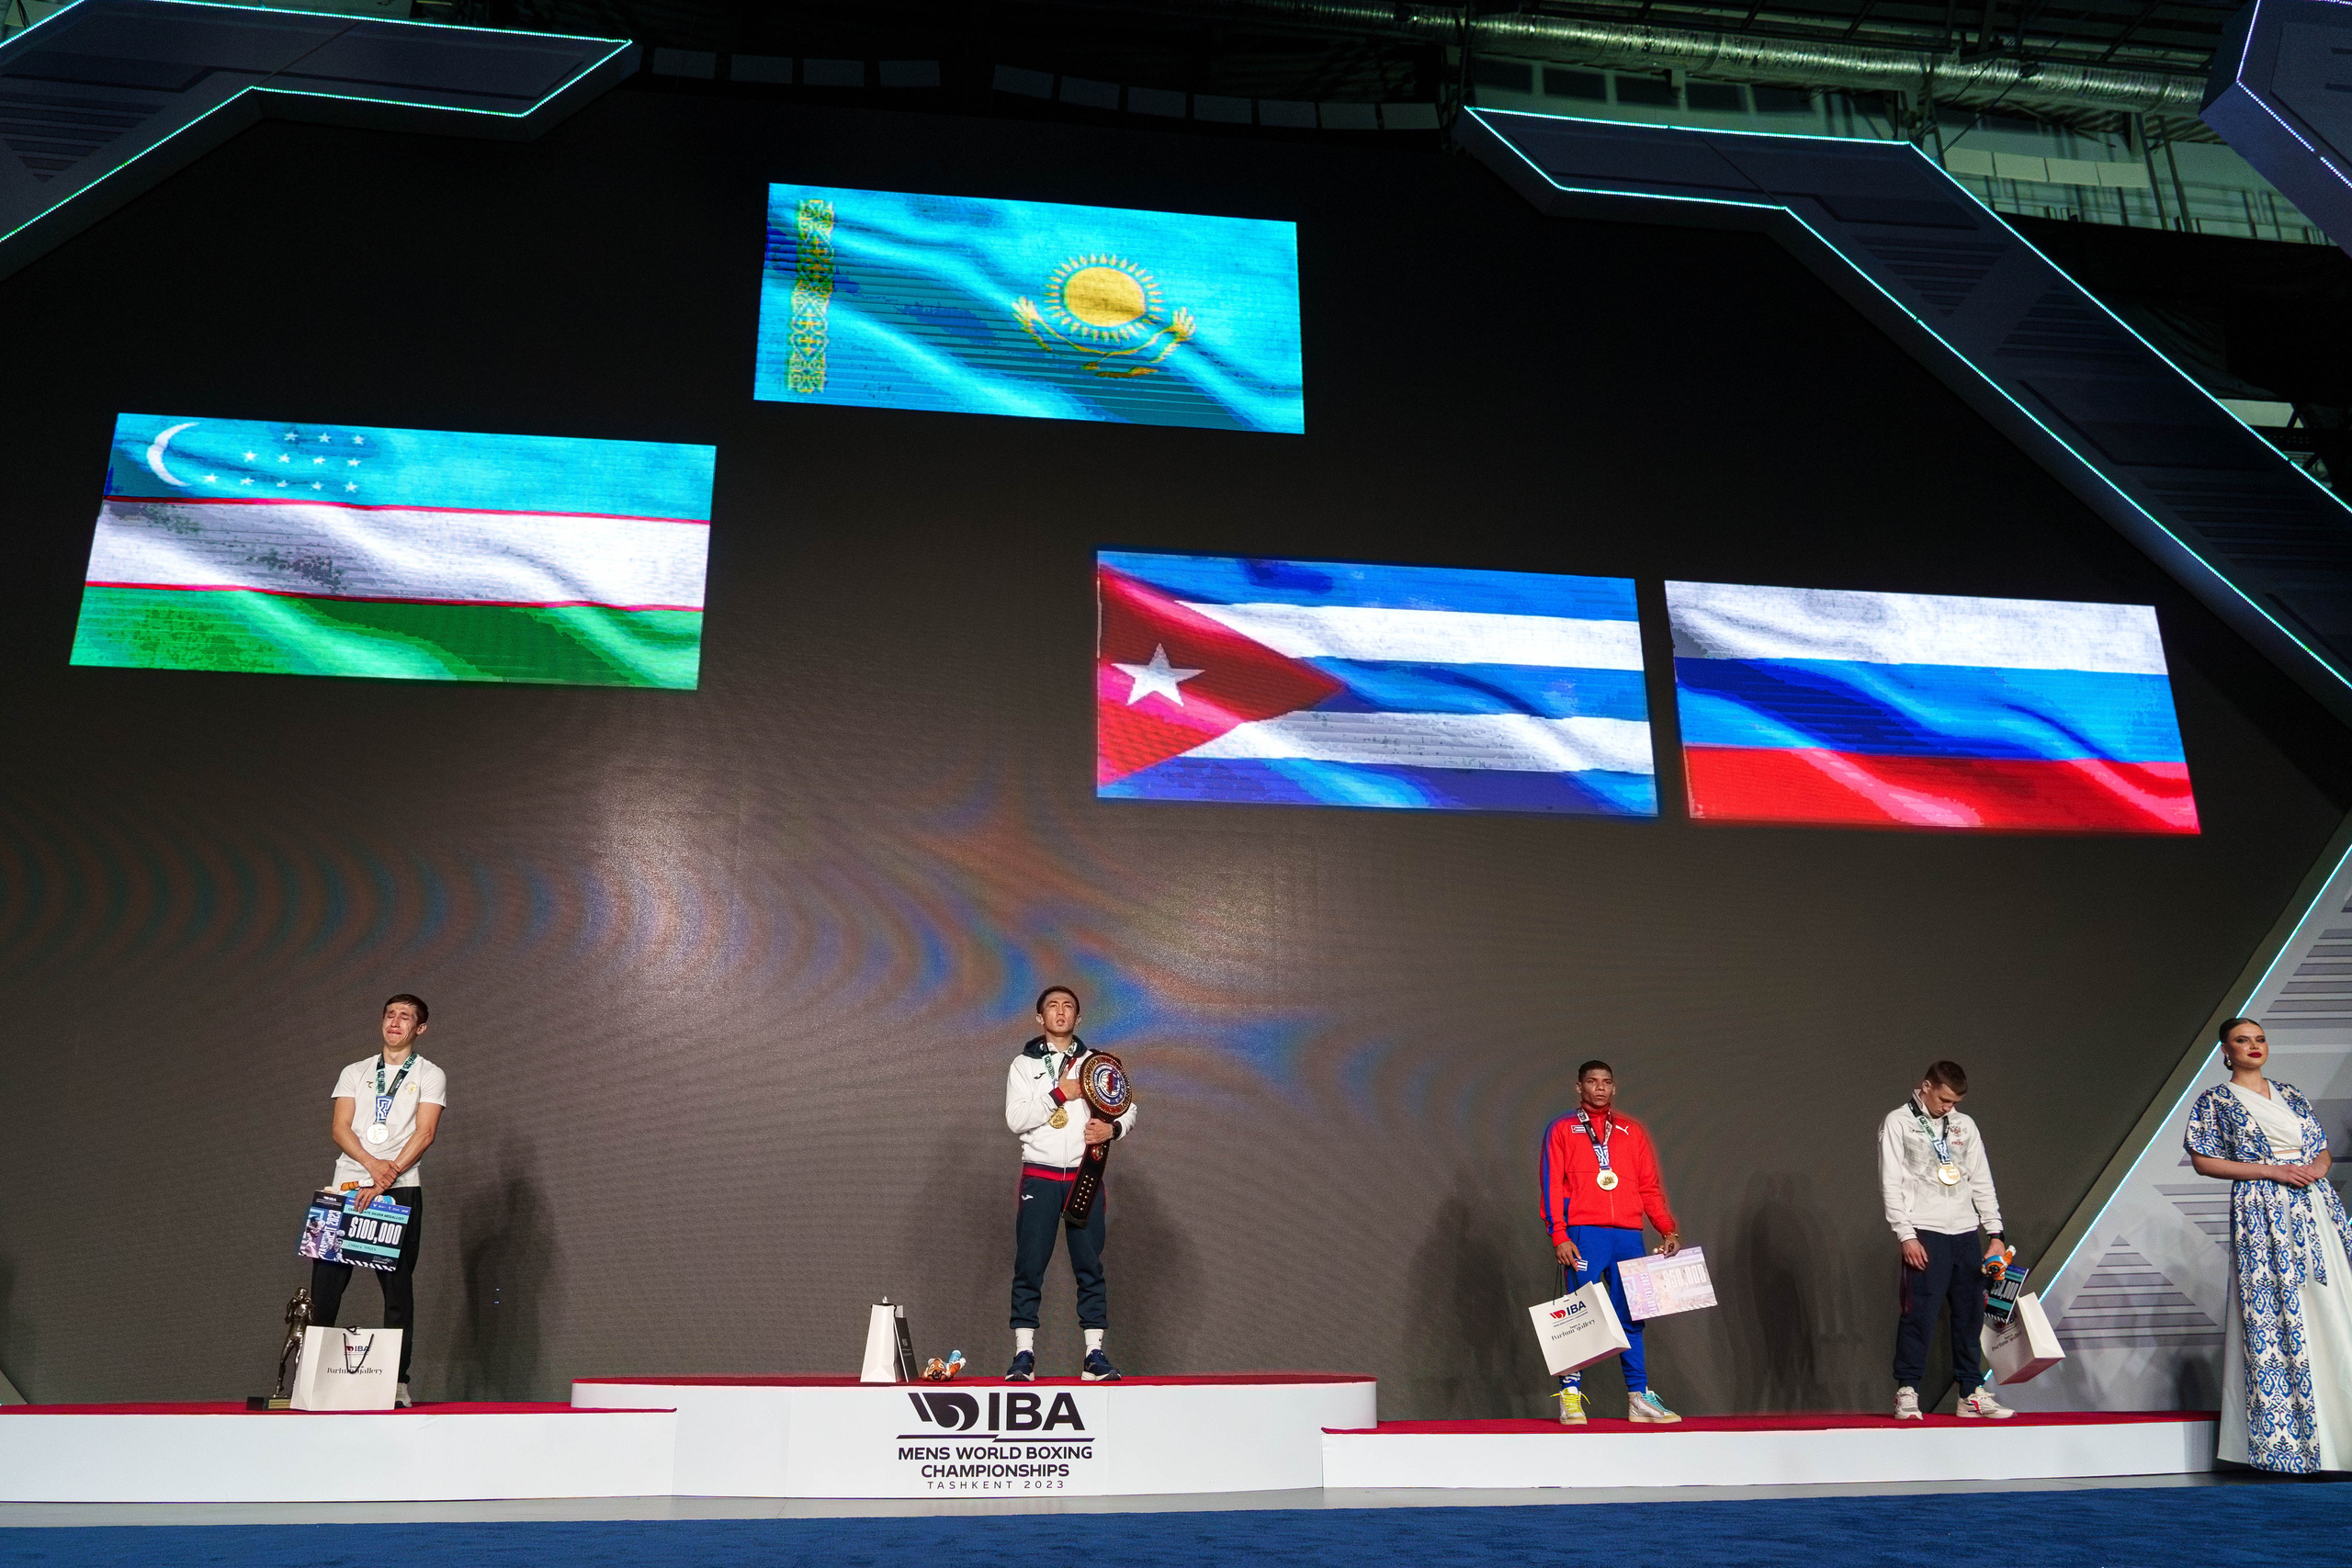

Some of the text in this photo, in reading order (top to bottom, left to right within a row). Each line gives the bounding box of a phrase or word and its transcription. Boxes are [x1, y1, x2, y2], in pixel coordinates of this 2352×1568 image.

[326, 1210, 342, 1226] 2023
[348, 1216, 402, 1245] $100,000
[1566, 1301, 1587, 1315] IBA
[988, 1392, 1086, 1431] IBA
[898, 1446, 1092, 1461] MENS WORLD BOXING
[921, 1463, 1070, 1478] CHAMPIONSHIPS
[927, 1480, 1065, 1490] TASHKENT 2023
